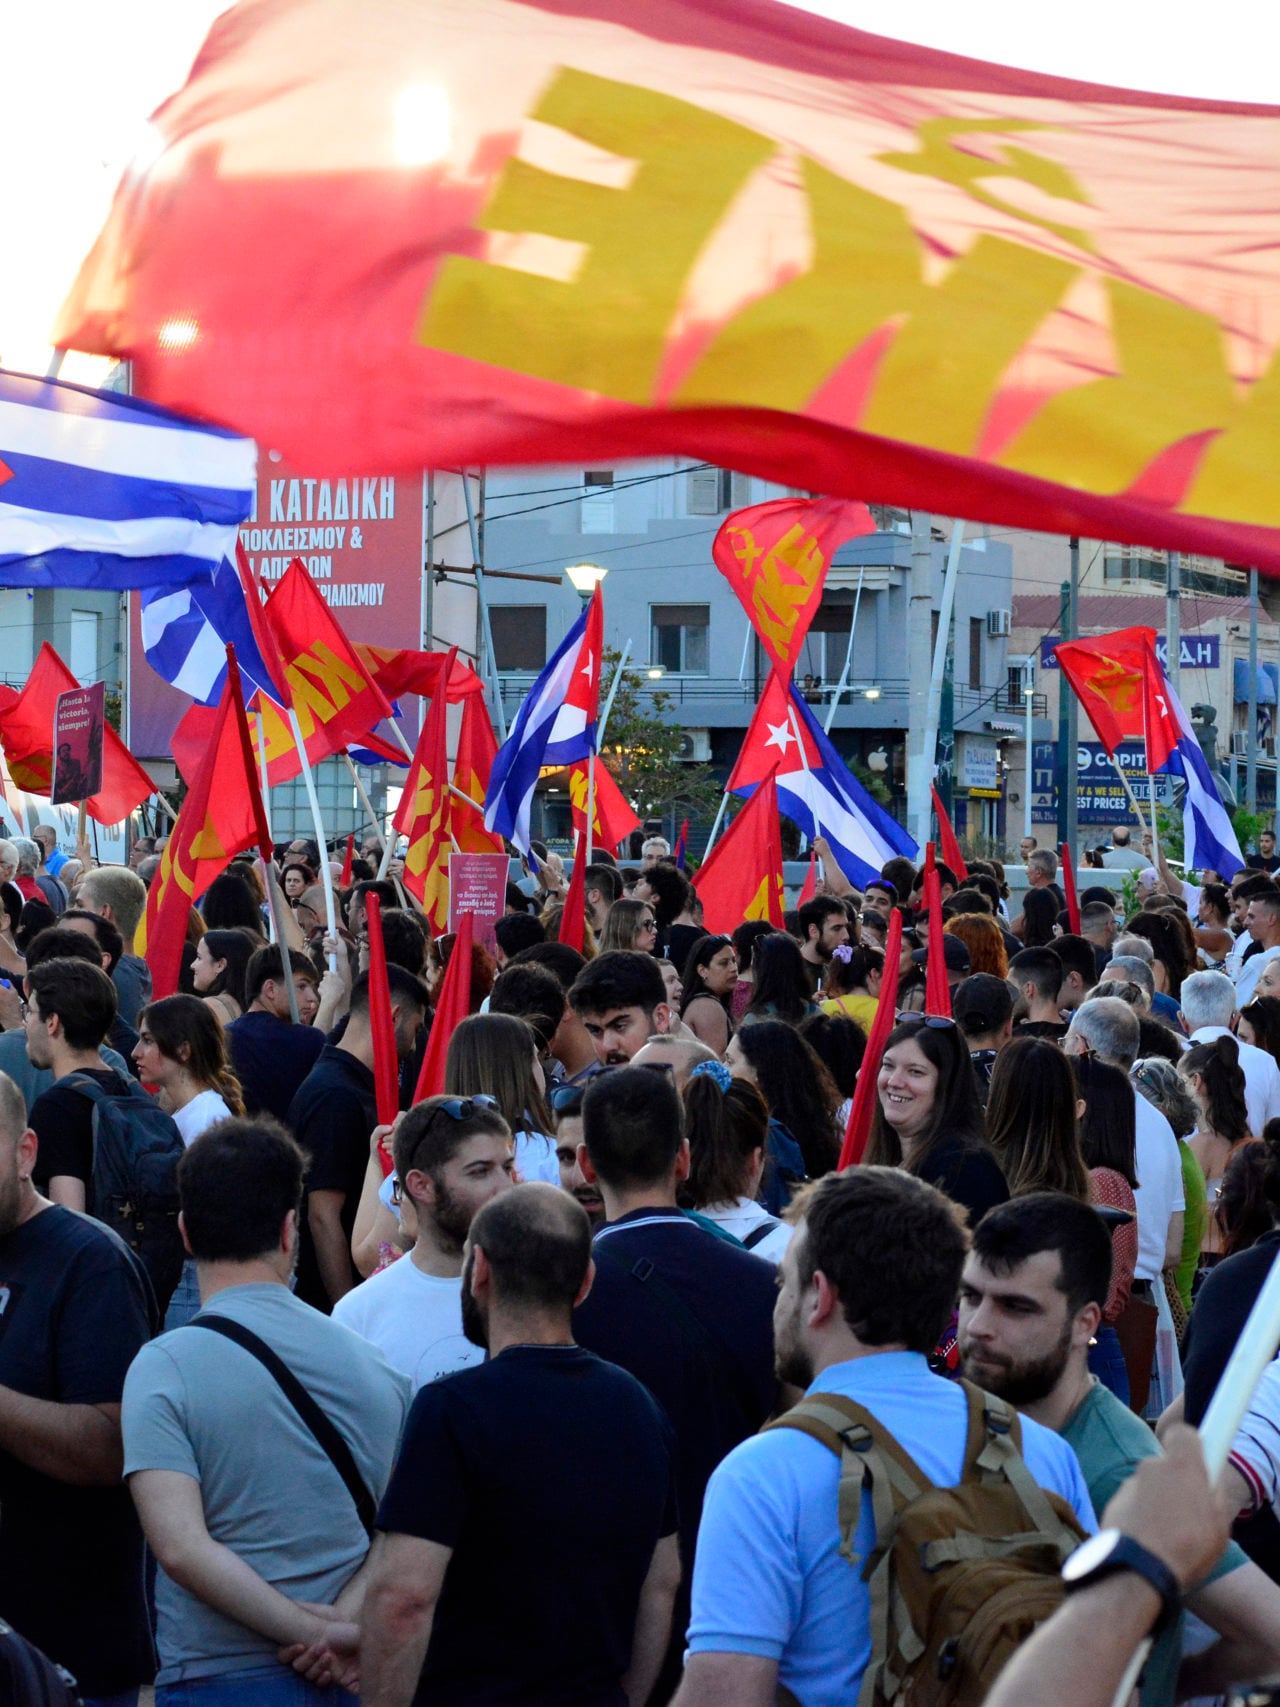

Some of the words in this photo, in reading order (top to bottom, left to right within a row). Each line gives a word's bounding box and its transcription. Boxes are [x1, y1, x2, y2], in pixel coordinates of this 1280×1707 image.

[270, 477, 395, 522] ΚΑΤΑΔΙΚΗ
[239, 527, 347, 552] ΠΟΚΛΕΙΣΜΟΥ
[350, 526, 363, 549] &
[260, 556, 333, 579] ΑΠΕΩΝ
[320, 583, 385, 607] ΡΙΑΛΙΣΜΟΥ
[1095, 752, 1146, 767] COPIT
[1109, 786, 1126, 797] SELL
[1076, 797, 1092, 809] EST
[1094, 798, 1126, 810] PRICES
